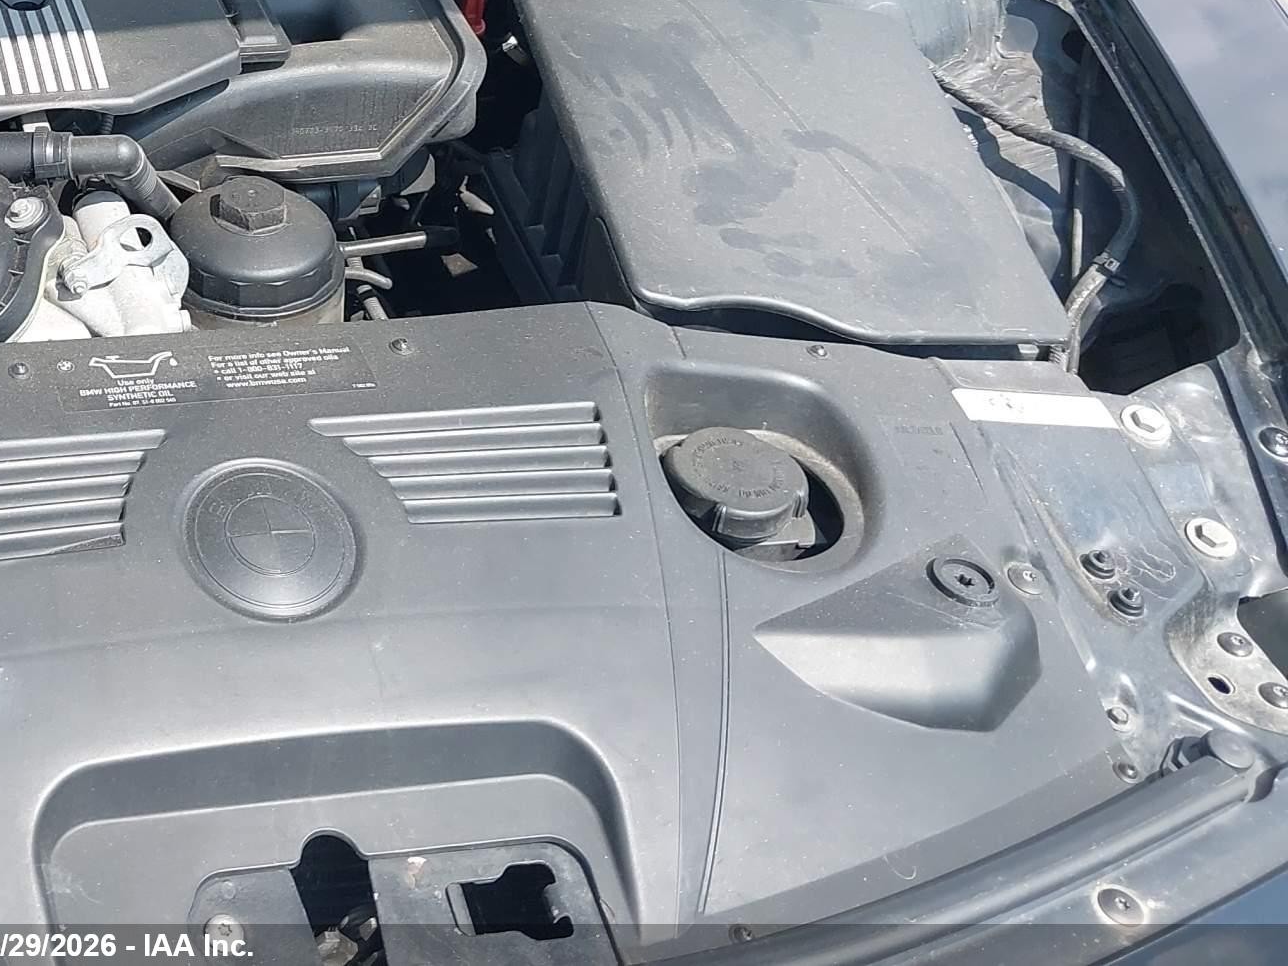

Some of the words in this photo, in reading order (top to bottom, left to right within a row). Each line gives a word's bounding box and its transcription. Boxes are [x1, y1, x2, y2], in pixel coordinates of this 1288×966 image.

[282, 349, 318, 357] Owner's
[318, 347, 350, 355] Manual
[283, 355, 322, 363] approved
[290, 369, 306, 377] site
[117, 378, 135, 387] Use
[136, 377, 155, 386] only
[225, 377, 307, 388] www.bmwusa.com
[79, 387, 102, 396] BMW
[104, 386, 127, 395] HIGH
[128, 380, 197, 393] PERFORMANCE
[107, 391, 158, 402] SYNTHETIC
[158, 389, 174, 397] OIL
